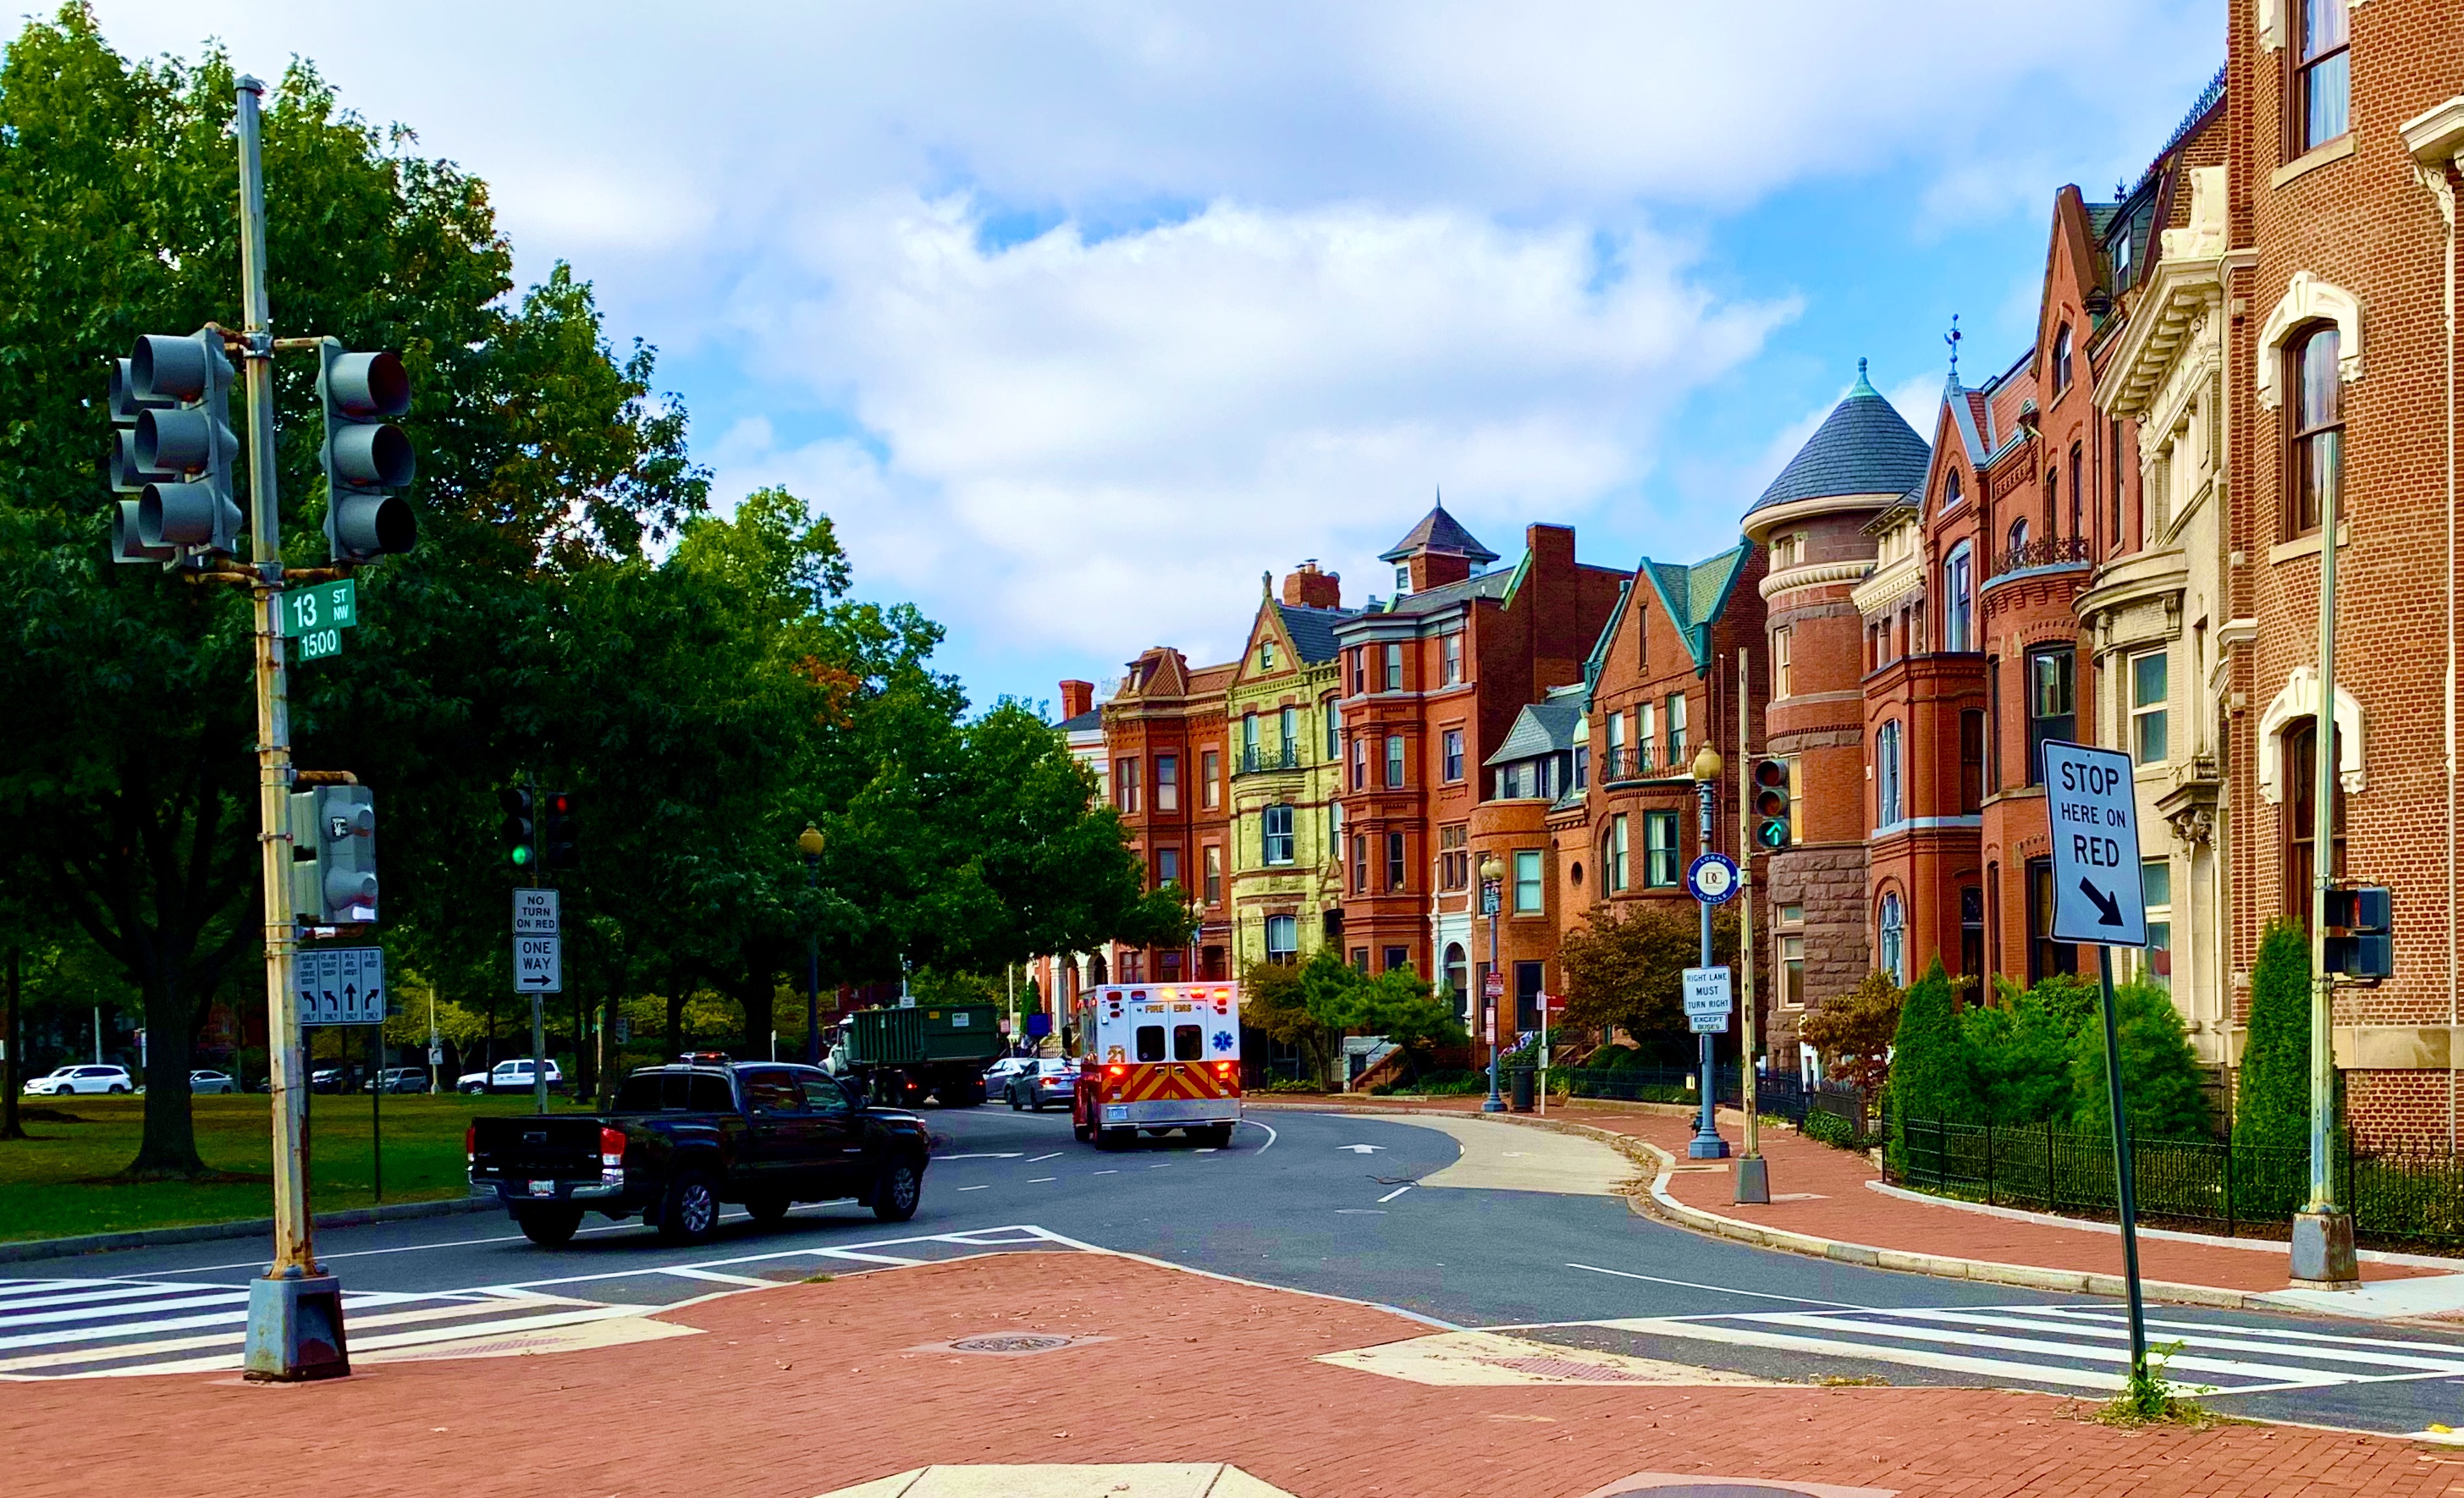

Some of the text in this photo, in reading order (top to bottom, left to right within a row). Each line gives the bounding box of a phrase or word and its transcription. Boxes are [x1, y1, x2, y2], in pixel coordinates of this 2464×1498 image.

[333, 588, 346, 603] ST
[293, 593, 317, 628] 13
[333, 604, 349, 621] NW
[301, 629, 337, 657] 1500
[2061, 761, 2119, 796] STOP
[2061, 802, 2126, 828] HERE ON
[2074, 834, 2119, 867] RED
[1706, 872, 1723, 884] DC
[527, 896, 544, 905] NO
[1699, 893, 1727, 901] CIRCLE
[522, 907, 550, 916] TURN
[517, 919, 554, 928] ON RED
[522, 941, 551, 954] ONE
[523, 957, 551, 970] WAY
[1710, 972, 1727, 981] LANE
[1696, 986, 1718, 995] MUST
[1145, 1005, 1164, 1013] FIRE
[1709, 1000, 1728, 1008] RIGHT
[1107, 1048, 1125, 1063] 21
